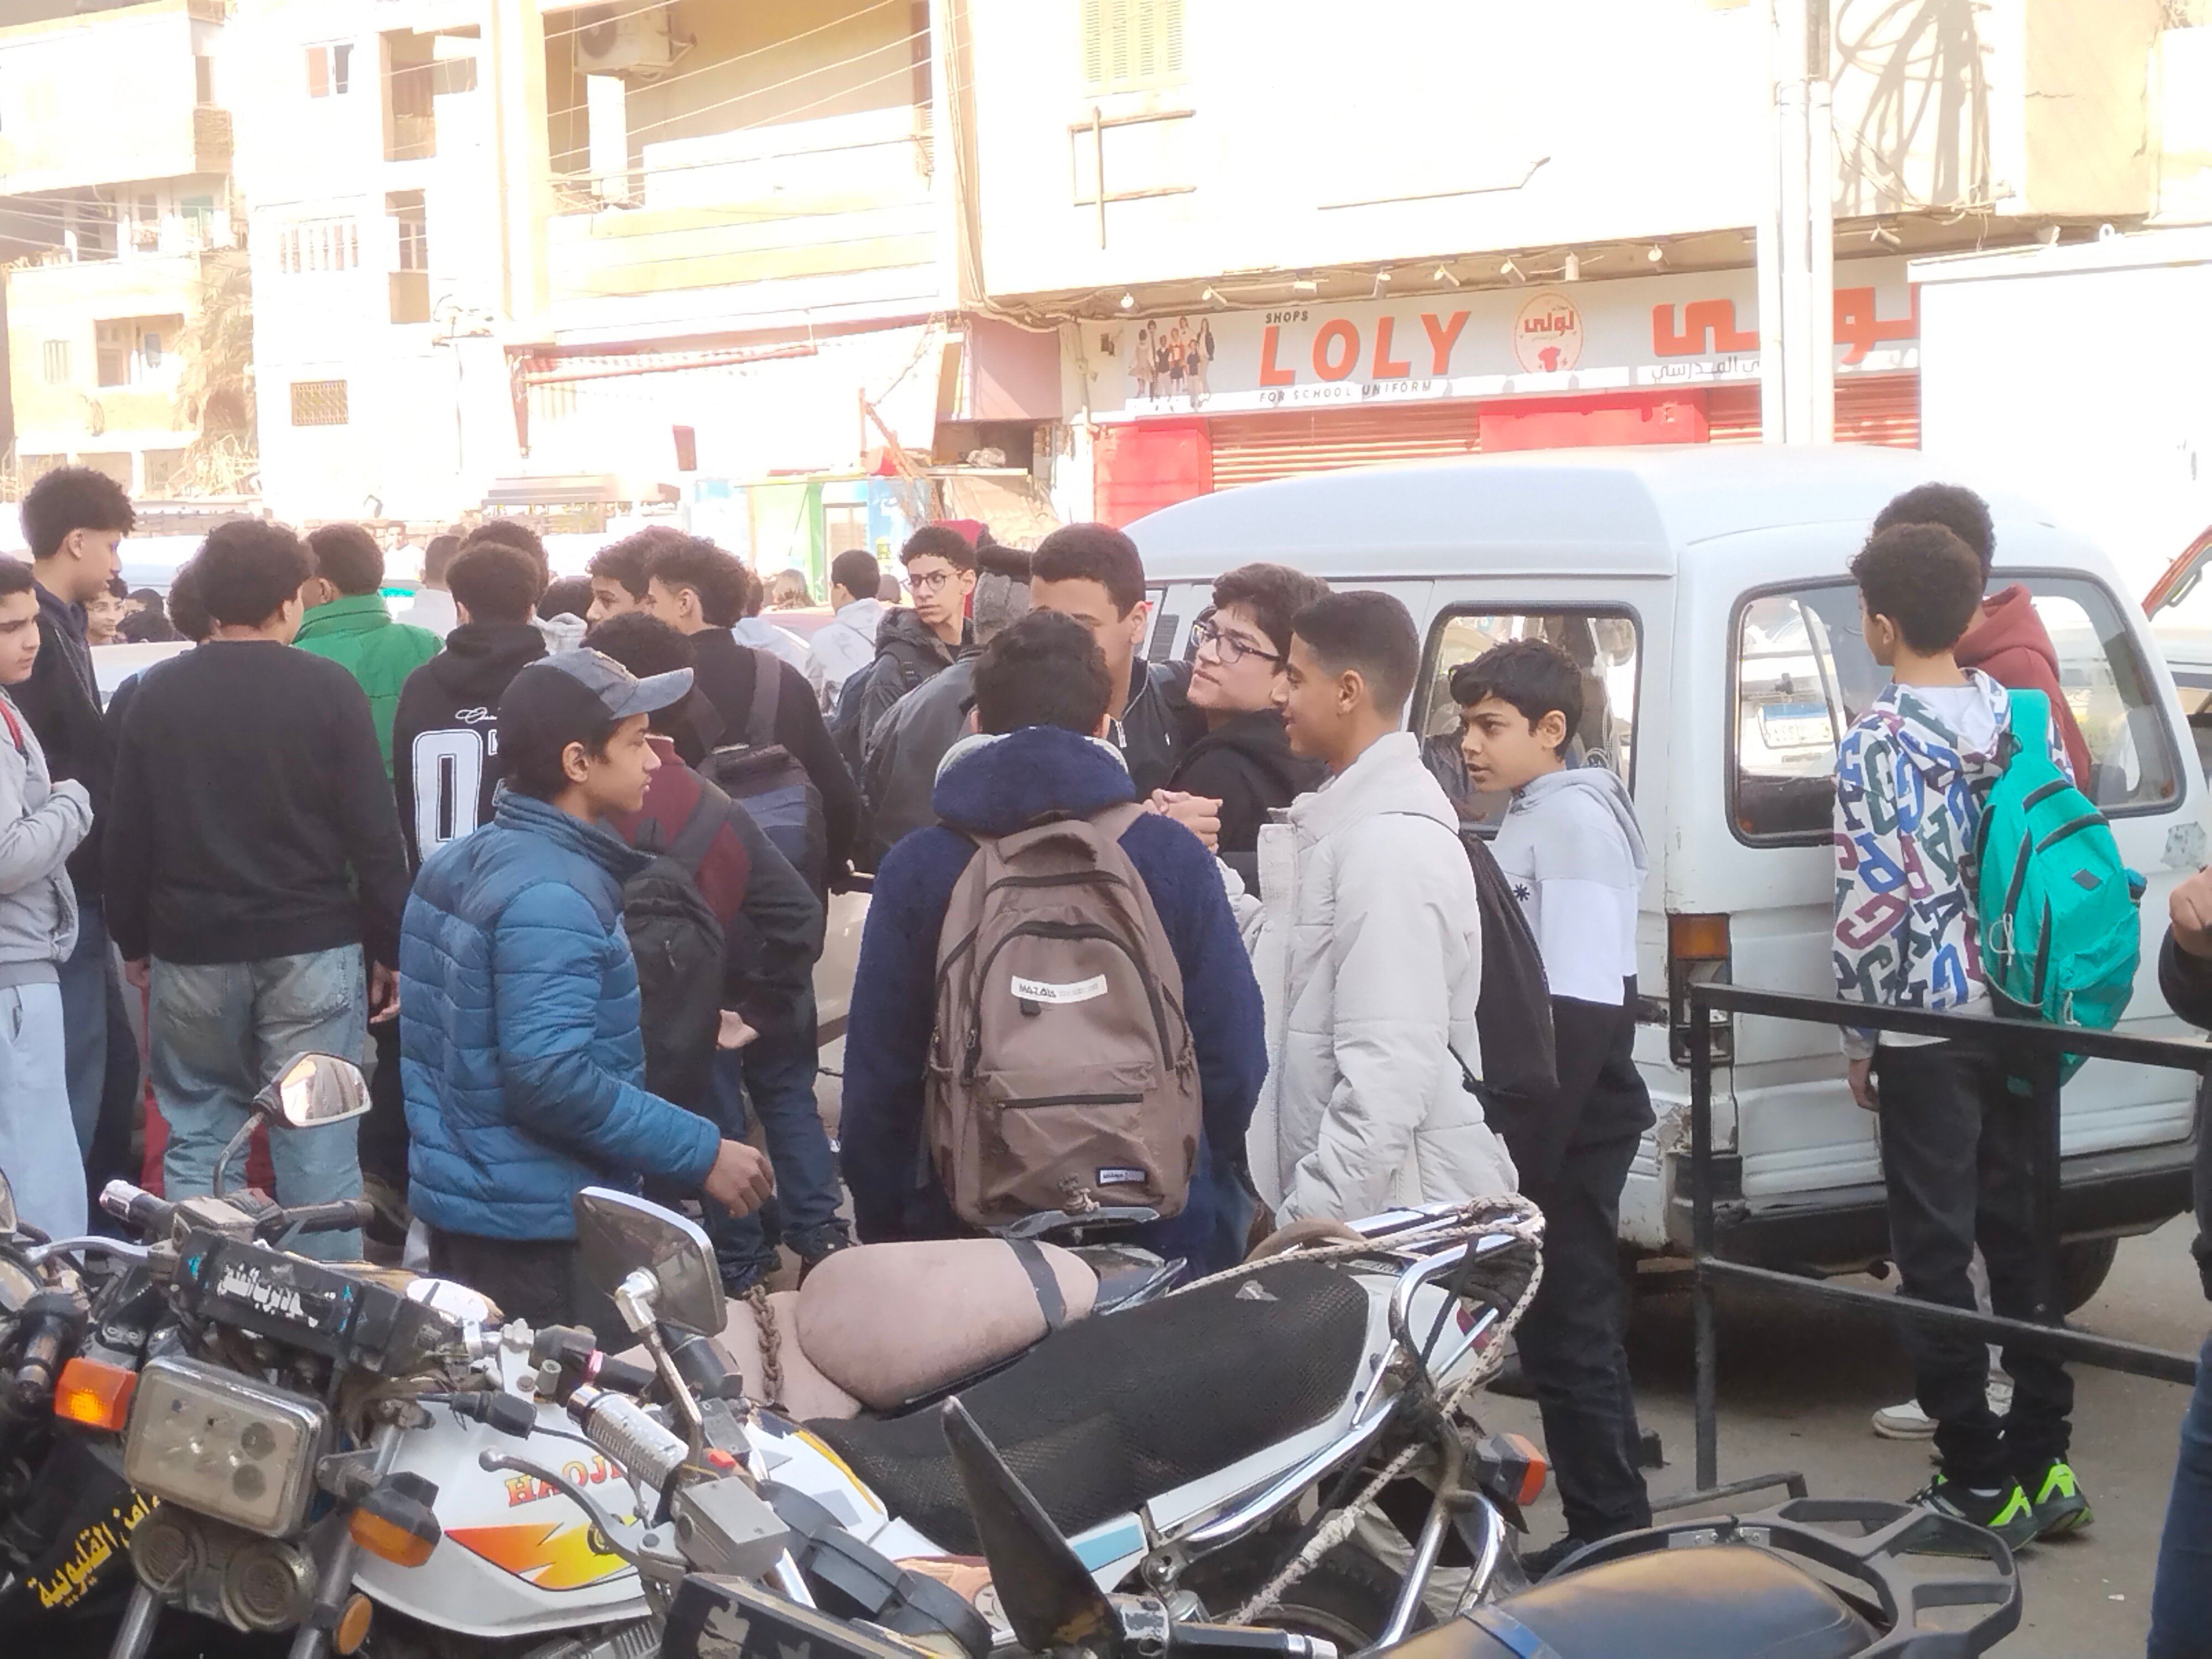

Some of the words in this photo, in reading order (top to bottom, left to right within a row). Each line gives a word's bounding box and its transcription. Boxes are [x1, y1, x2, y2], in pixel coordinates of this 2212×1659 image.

[1265, 310, 1310, 324] SHOPS
[1259, 310, 1472, 388] LOLY
[1259, 390, 1285, 403] FOR
[1293, 387, 1353, 400] SCHOOL
[1361, 380, 1432, 397] UNIFORM
[26, 1521, 119, 1609] القليوبية
